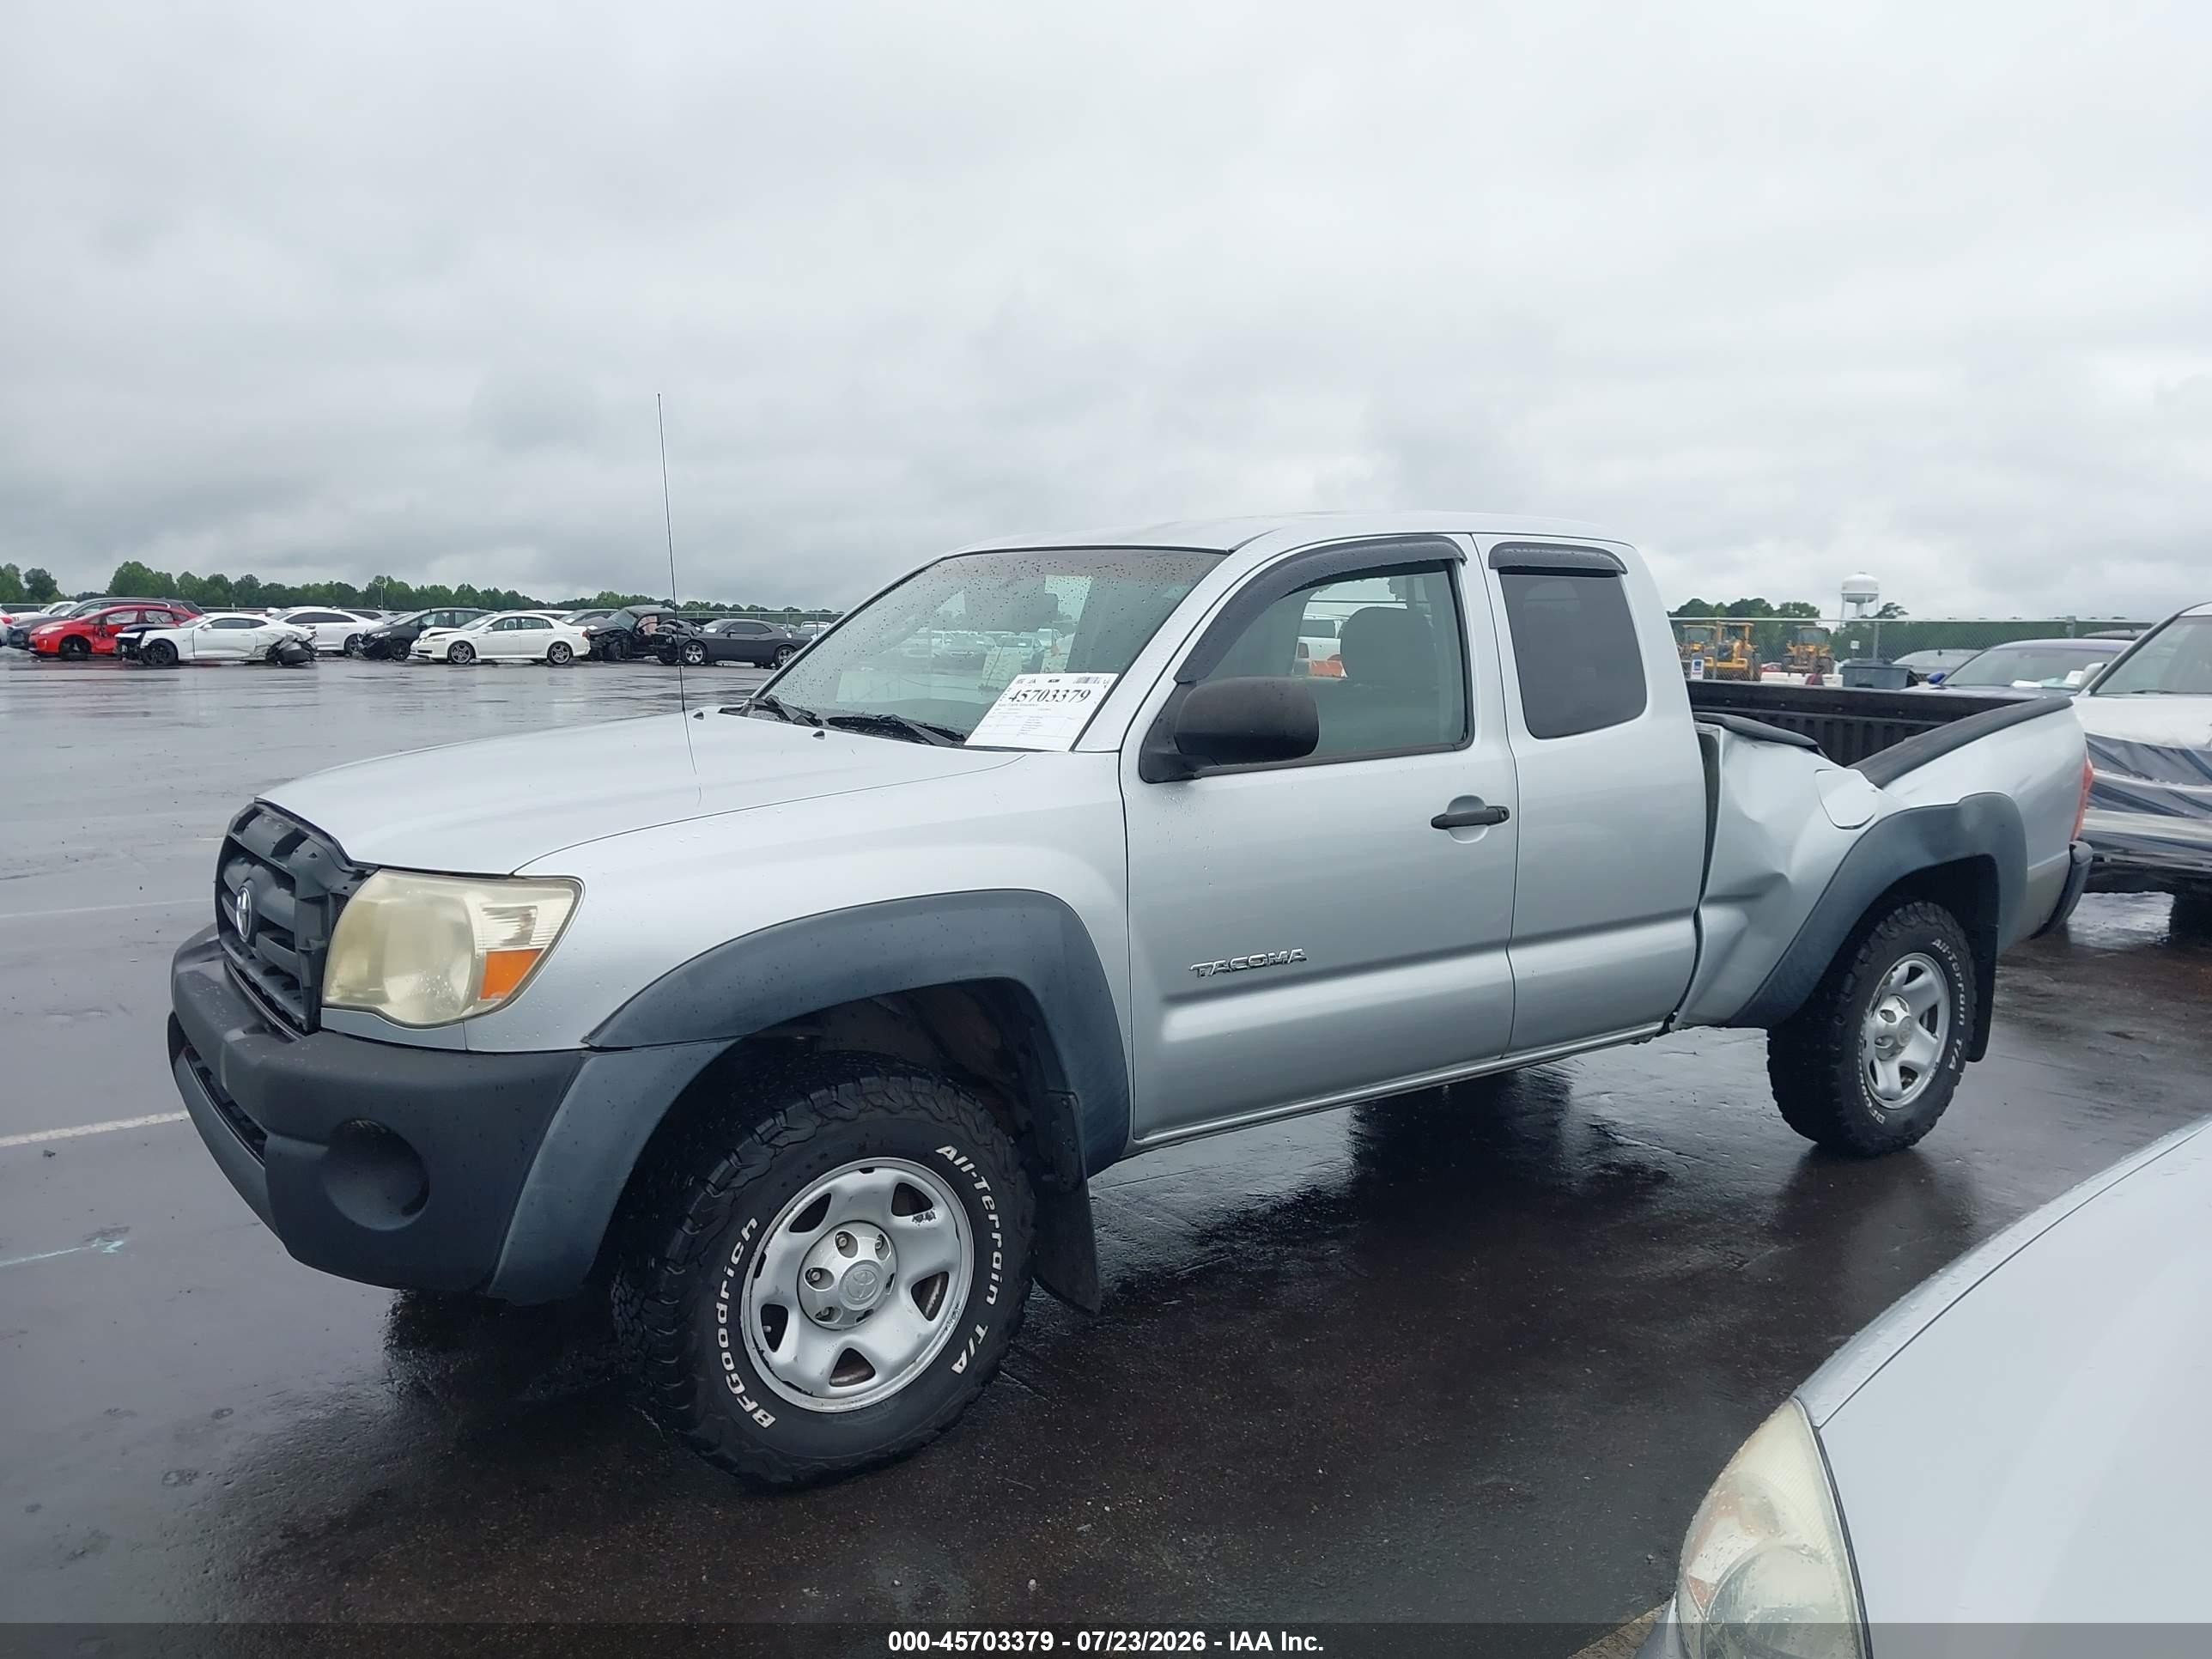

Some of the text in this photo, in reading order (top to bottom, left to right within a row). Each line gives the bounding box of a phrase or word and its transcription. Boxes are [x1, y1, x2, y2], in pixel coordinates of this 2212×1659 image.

[1008, 689, 1091, 702] 45703379
[1189, 948, 1307, 977] TACOMA
[935, 1145, 1004, 1374] All-Terrain T/A
[715, 1217, 776, 1428] BFGoodrich
